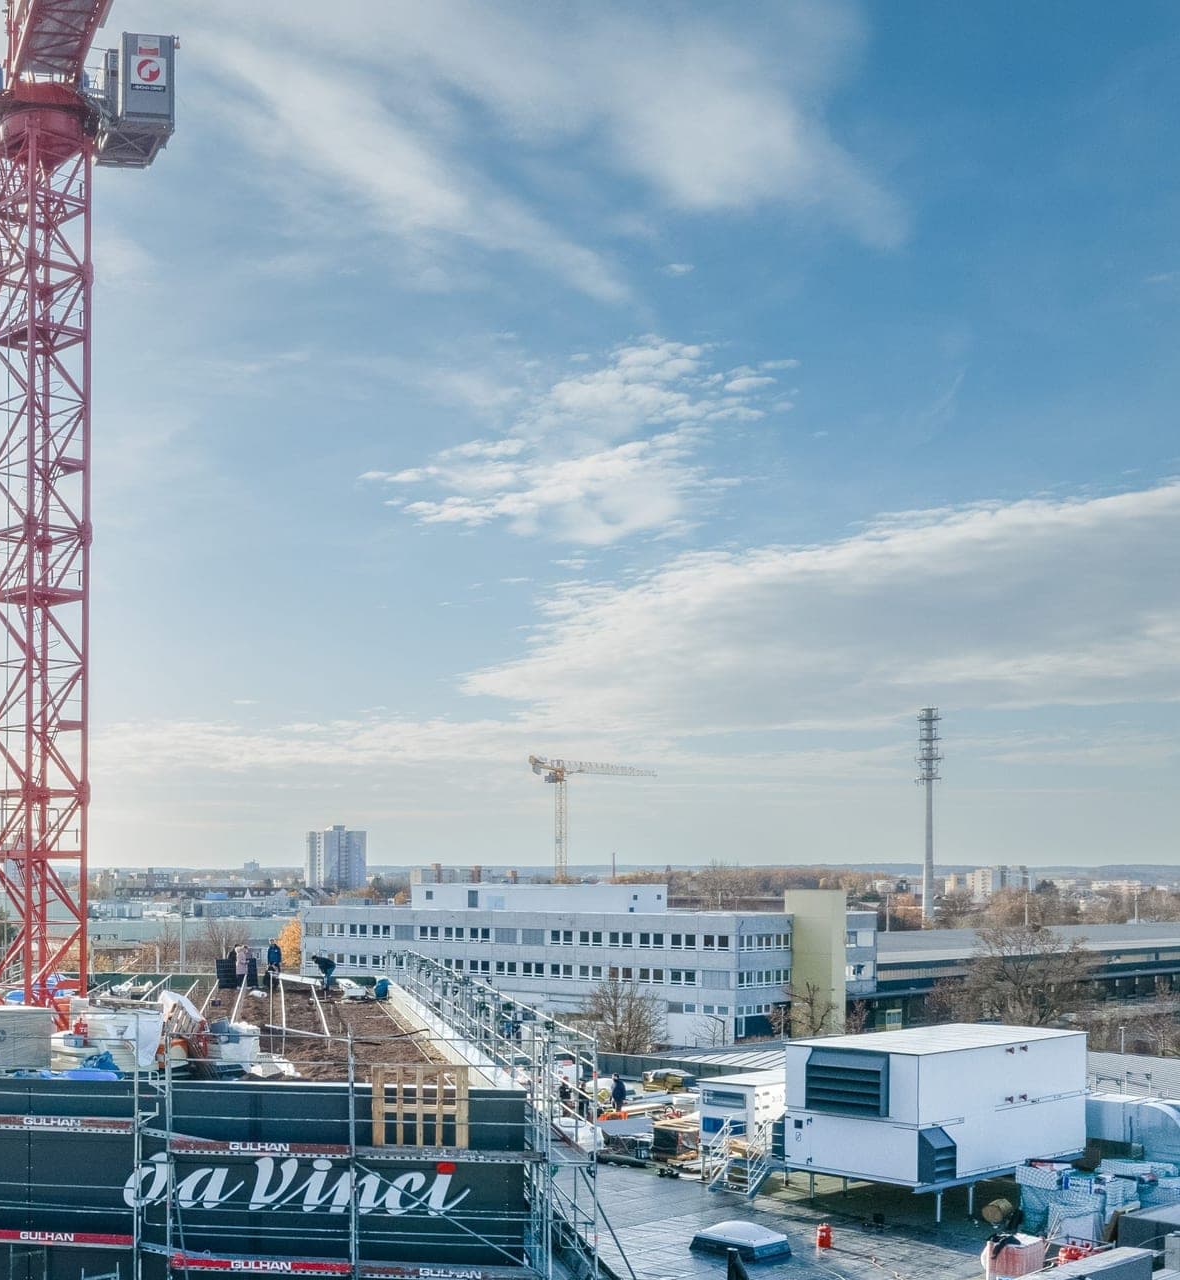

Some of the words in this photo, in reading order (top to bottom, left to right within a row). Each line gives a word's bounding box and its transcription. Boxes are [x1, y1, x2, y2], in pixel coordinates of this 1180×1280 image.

[23, 1117, 80, 1127] GULHAN
[229, 1141, 290, 1152] GULHAN
[20, 1231, 74, 1242] GULHAN
[231, 1260, 292, 1272] GULHAN
